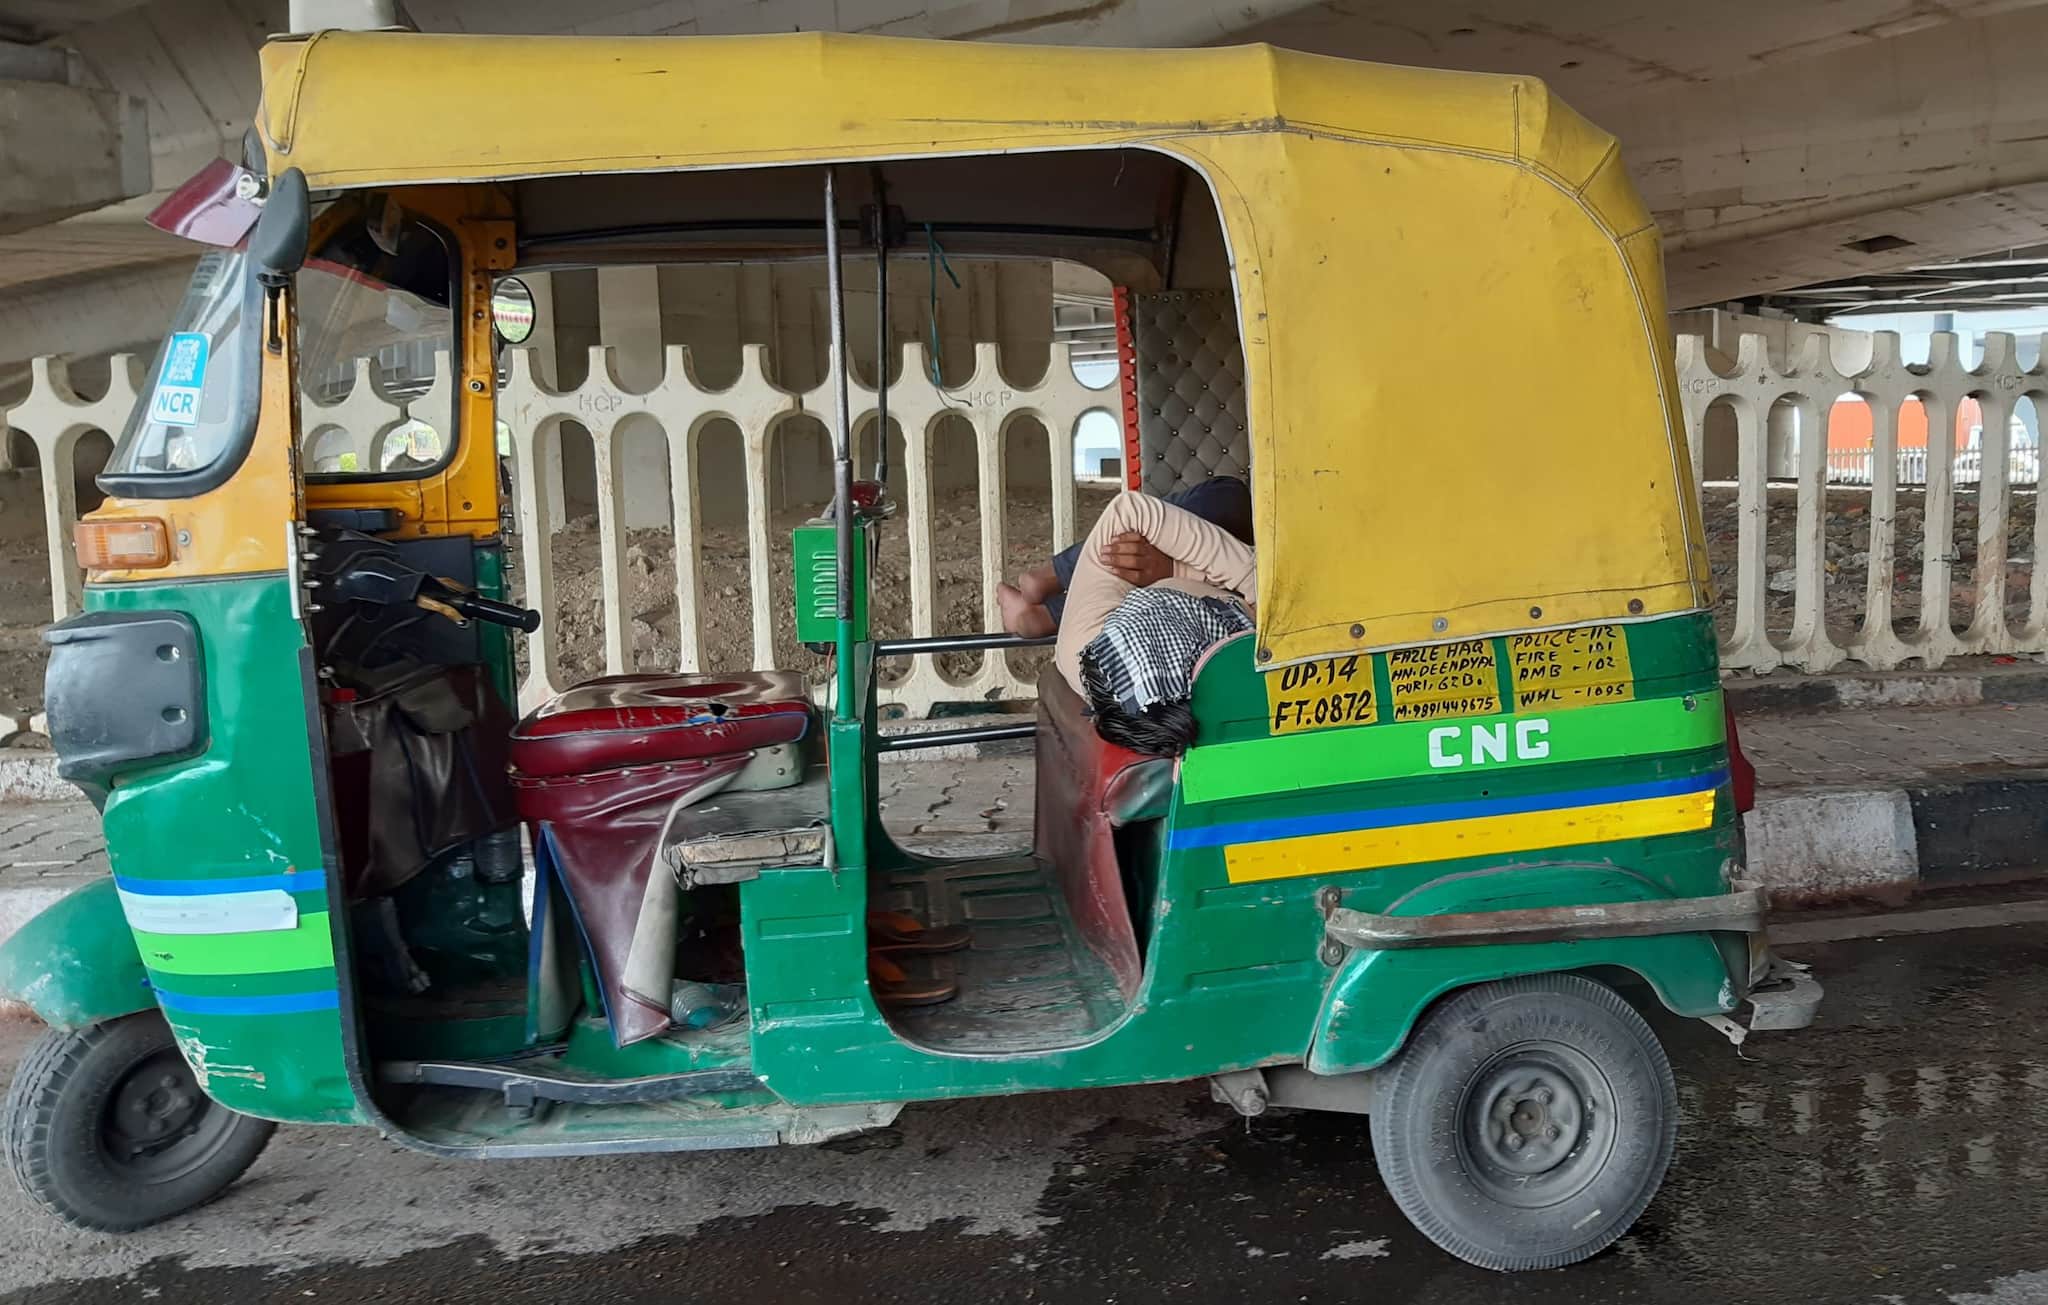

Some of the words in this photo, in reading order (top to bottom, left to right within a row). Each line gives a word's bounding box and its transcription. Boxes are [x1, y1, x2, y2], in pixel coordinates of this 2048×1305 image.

[156, 392, 193, 413] NCR
[579, 393, 622, 411] HCP
[969, 391, 1012, 407] HCP
[1446, 641, 1484, 658] HAQ
[1516, 651, 1558, 665] FIRE
[1281, 656, 1359, 691] UP.14
[1521, 689, 1562, 706] WHL
[1275, 690, 1371, 730] FT.0872
[1428, 718, 1550, 768] CNG
